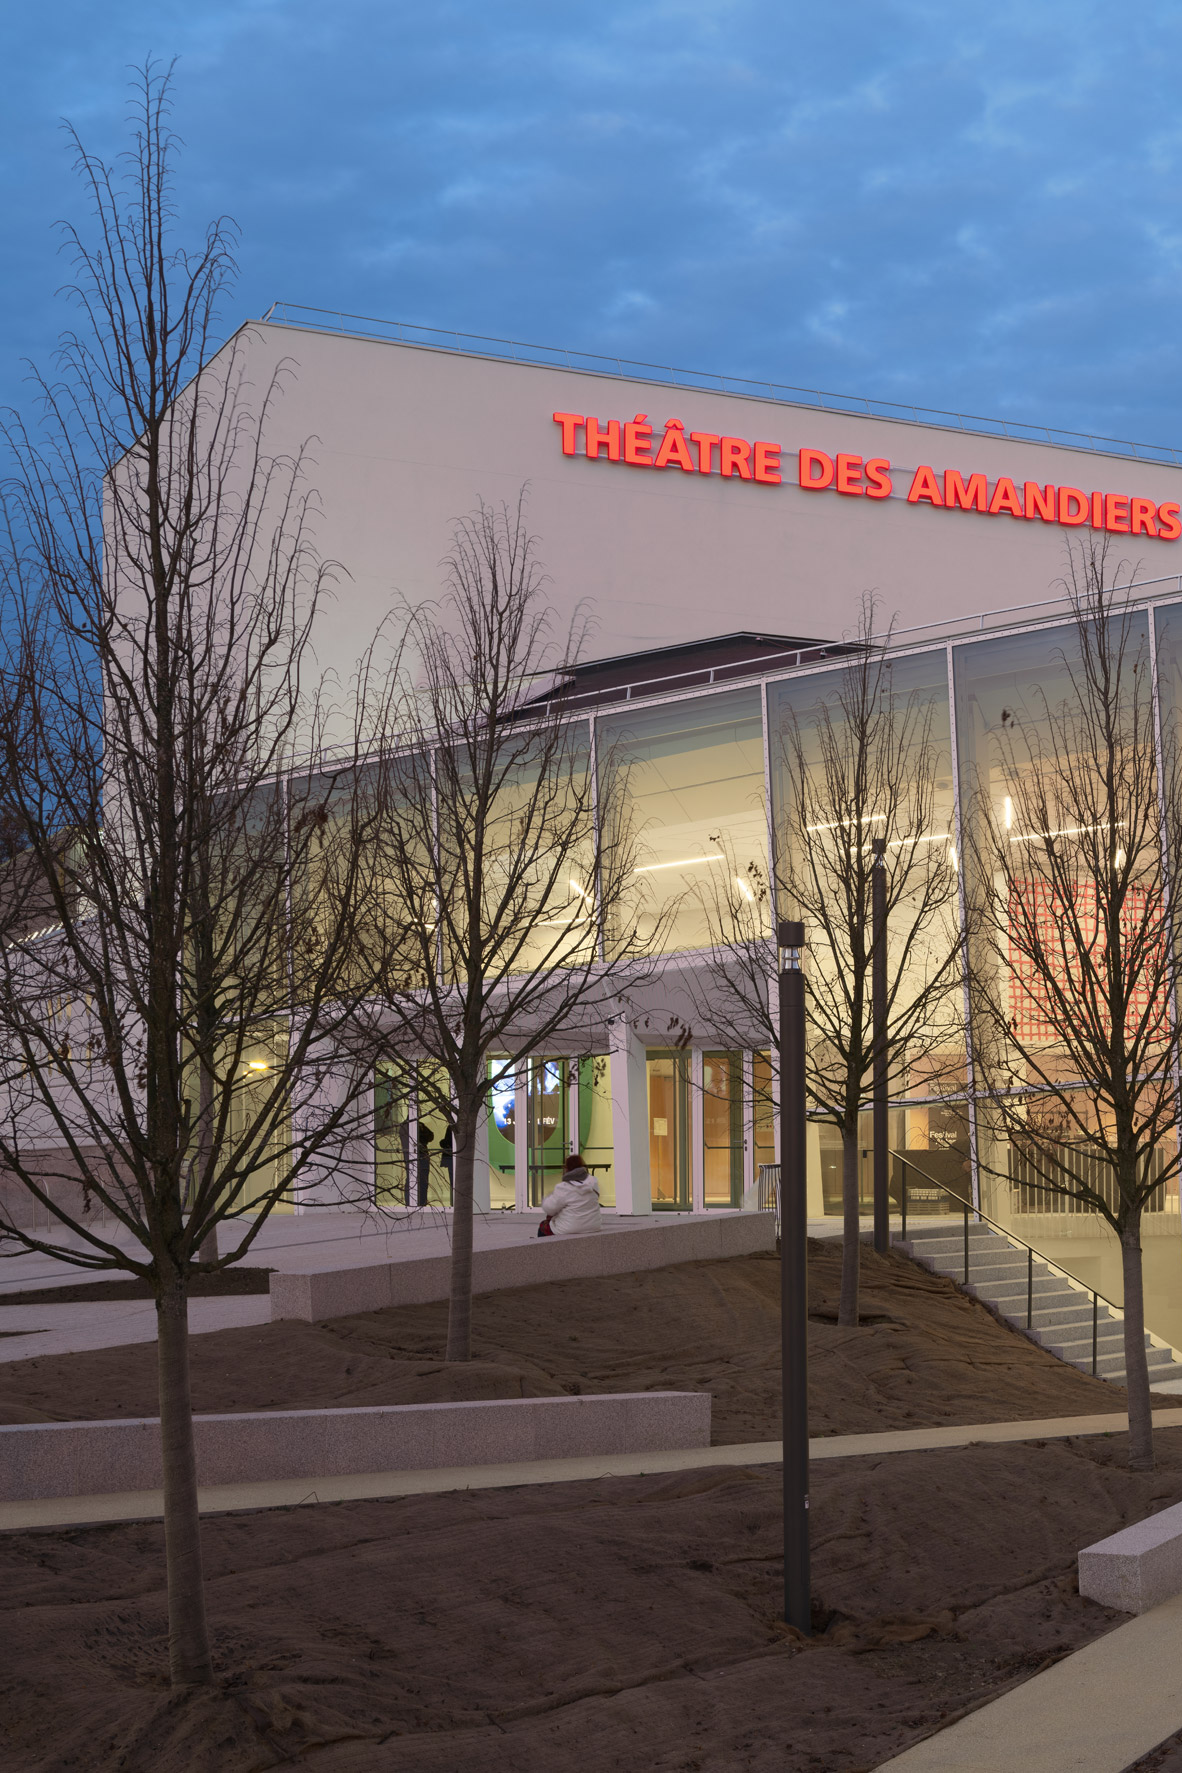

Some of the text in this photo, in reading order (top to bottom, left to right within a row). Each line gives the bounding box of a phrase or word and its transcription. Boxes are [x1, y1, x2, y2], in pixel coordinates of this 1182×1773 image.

[553, 412, 1182, 541] THÉÂTRE DES AMANDIERS
